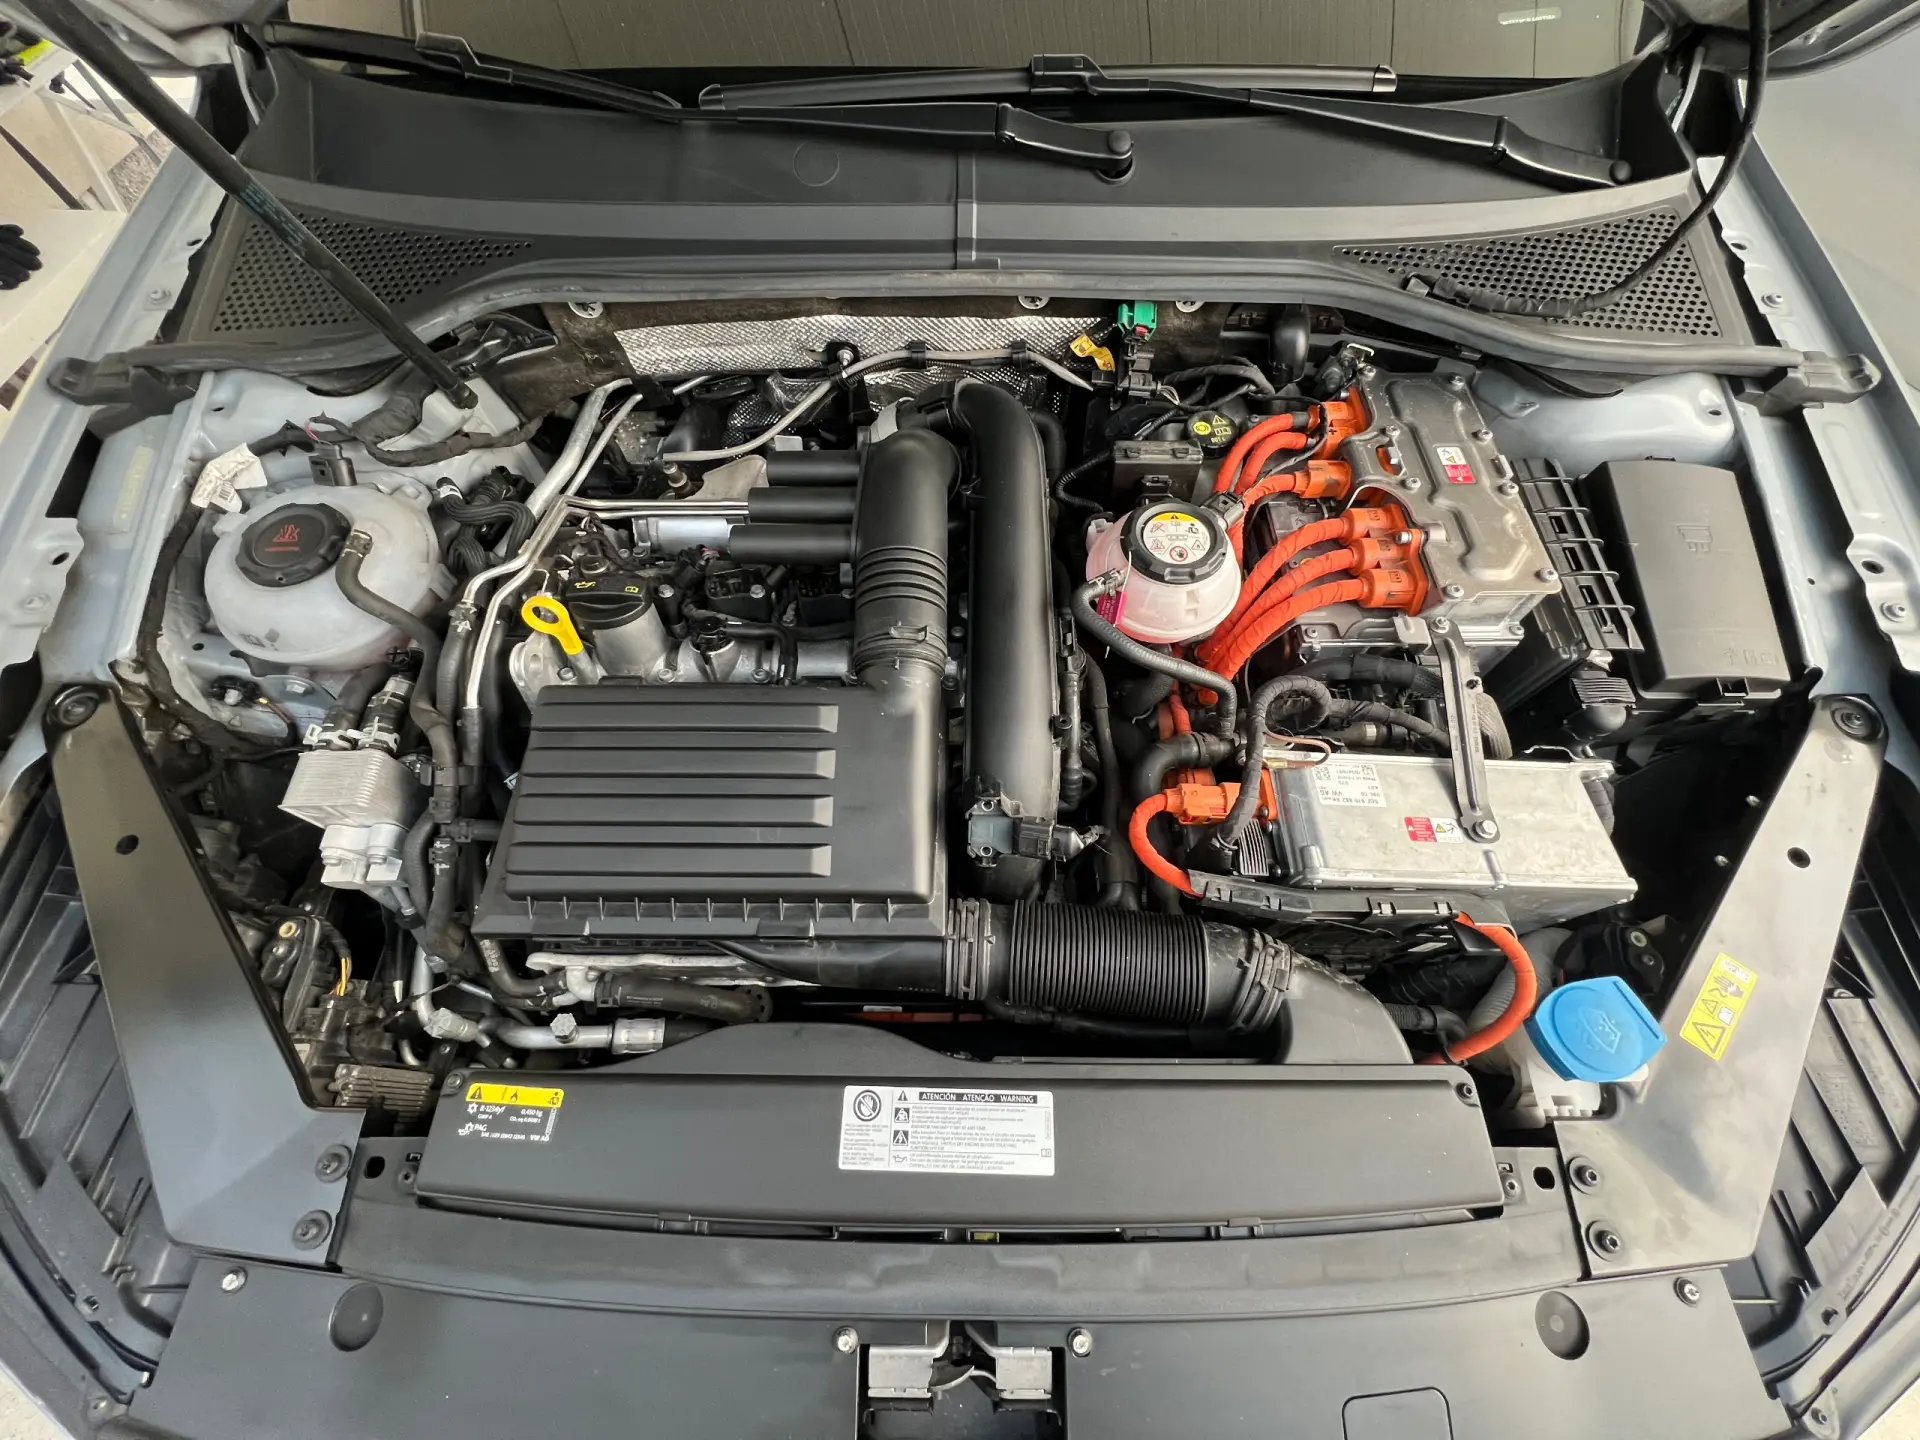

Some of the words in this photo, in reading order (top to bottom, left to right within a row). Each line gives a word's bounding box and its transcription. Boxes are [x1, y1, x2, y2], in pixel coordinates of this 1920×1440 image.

[922, 1092, 957, 1101] ATENCIÓN
[962, 1092, 995, 1103] ATENÇÃO
[1000, 1094, 1034, 1103] WARNING
[480, 1104, 506, 1115] R-1234yf
[474, 1124, 488, 1132] PAG
